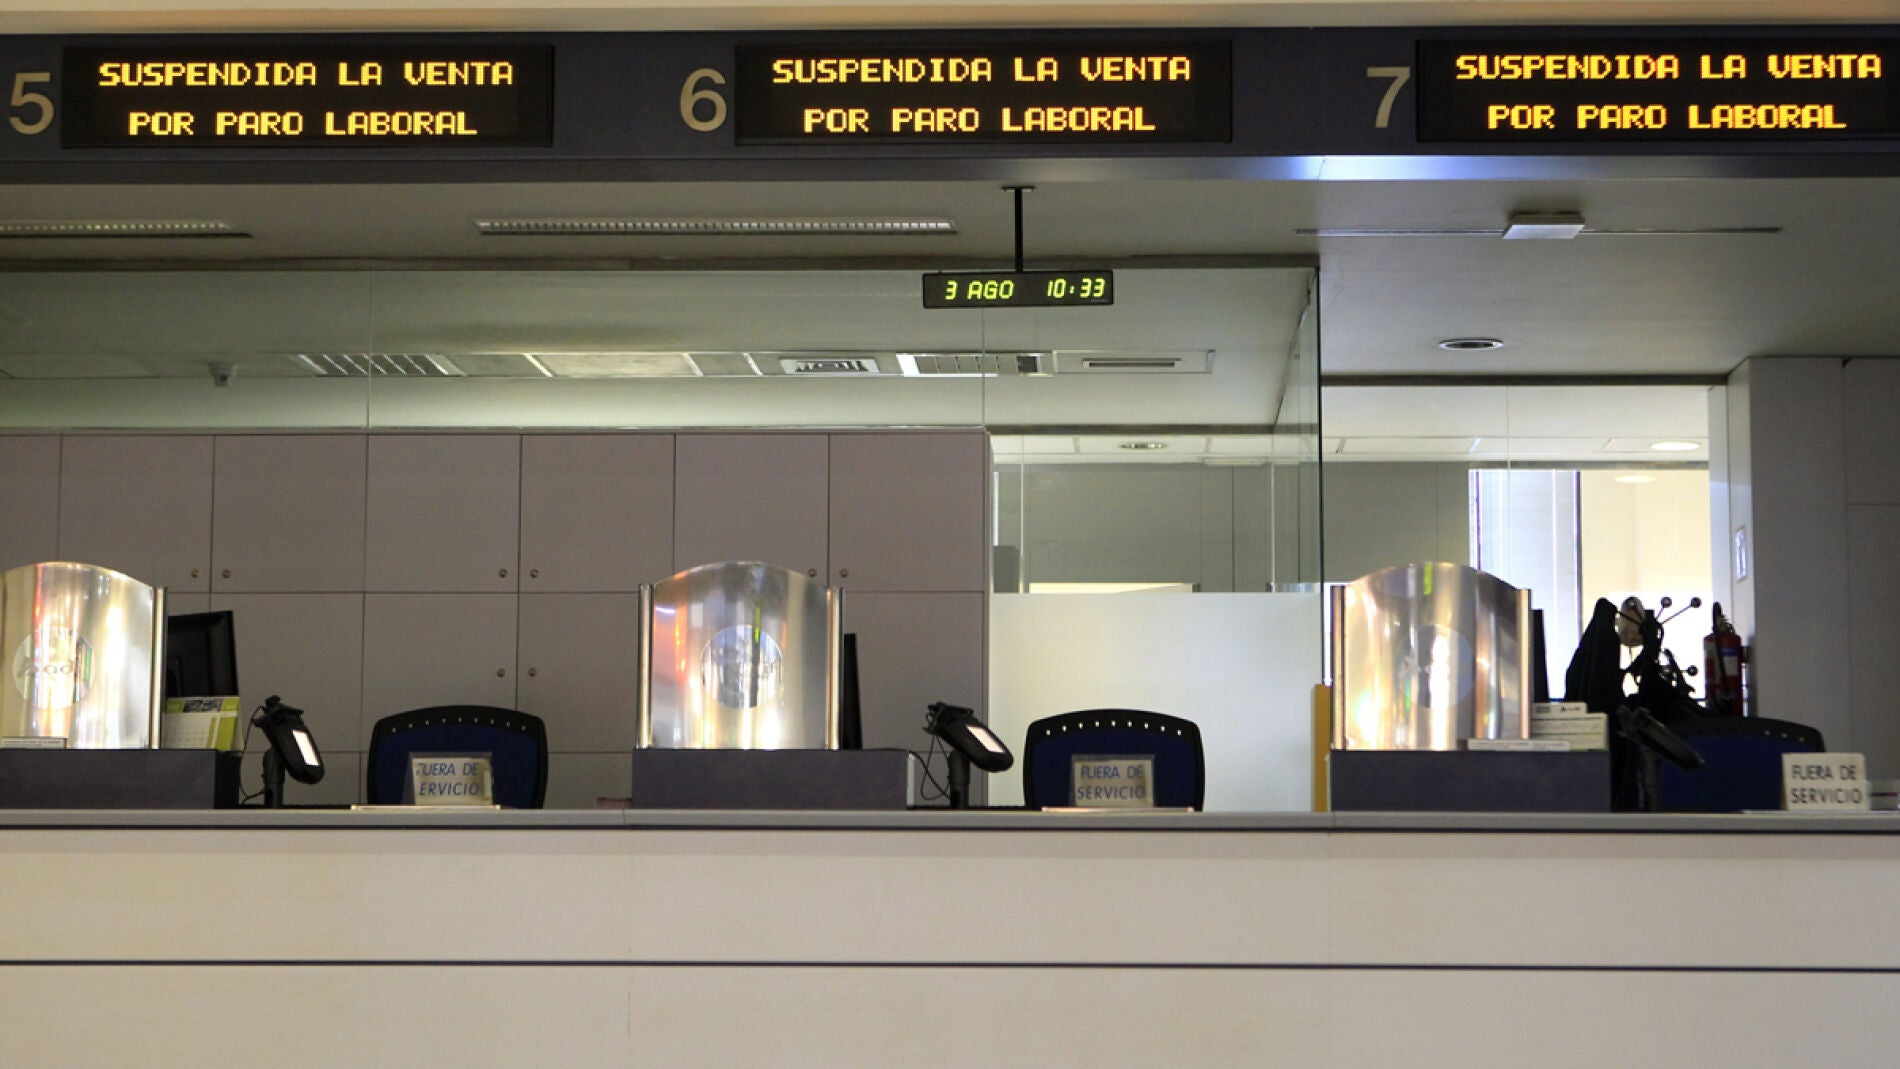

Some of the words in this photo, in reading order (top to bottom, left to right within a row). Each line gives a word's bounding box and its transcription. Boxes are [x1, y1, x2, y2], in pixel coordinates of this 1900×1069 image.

[100, 62, 317, 87] SUSPENDIDA
[339, 62, 383, 86] LA
[404, 61, 513, 86] VENTA
[772, 57, 992, 84] SUSPENDIDA
[1014, 56, 1059, 82] LA
[1080, 56, 1192, 82] VENTA
[1455, 54, 1681, 80] SUSPENDIDA
[1700, 54, 1747, 79] LA
[1767, 53, 1883, 79] VENTA
[9, 72, 54, 135] 5
[678, 68, 728, 132] 6
[1366, 66, 1412, 128] 7
[128, 111, 195, 136] POR
[216, 111, 304, 136] PARO
[325, 111, 478, 136] LABORAL
[803, 108, 869, 134] POR
[892, 107, 980, 133] PARO
[1001, 106, 1157, 132] LABORAL
[1487, 104, 1556, 130] POR
[1576, 104, 1667, 129] PARO
[1688, 103, 1848, 129] LABORAL
[944, 280, 958, 300] 3
[967, 280, 1015, 300] AGO
[1047, 278, 1106, 299] 10:33
[462, 762, 479, 777] DE
[1080, 765, 1120, 779] FUERA
[1127, 765, 1144, 779] DE
[1792, 764, 1833, 780] FUERA
[1840, 764, 1857, 780] DE
[419, 782, 481, 796] ERVICIO
[1077, 785, 1146, 800] SERVICIO
[1791, 787, 1863, 804] SERVICIO
